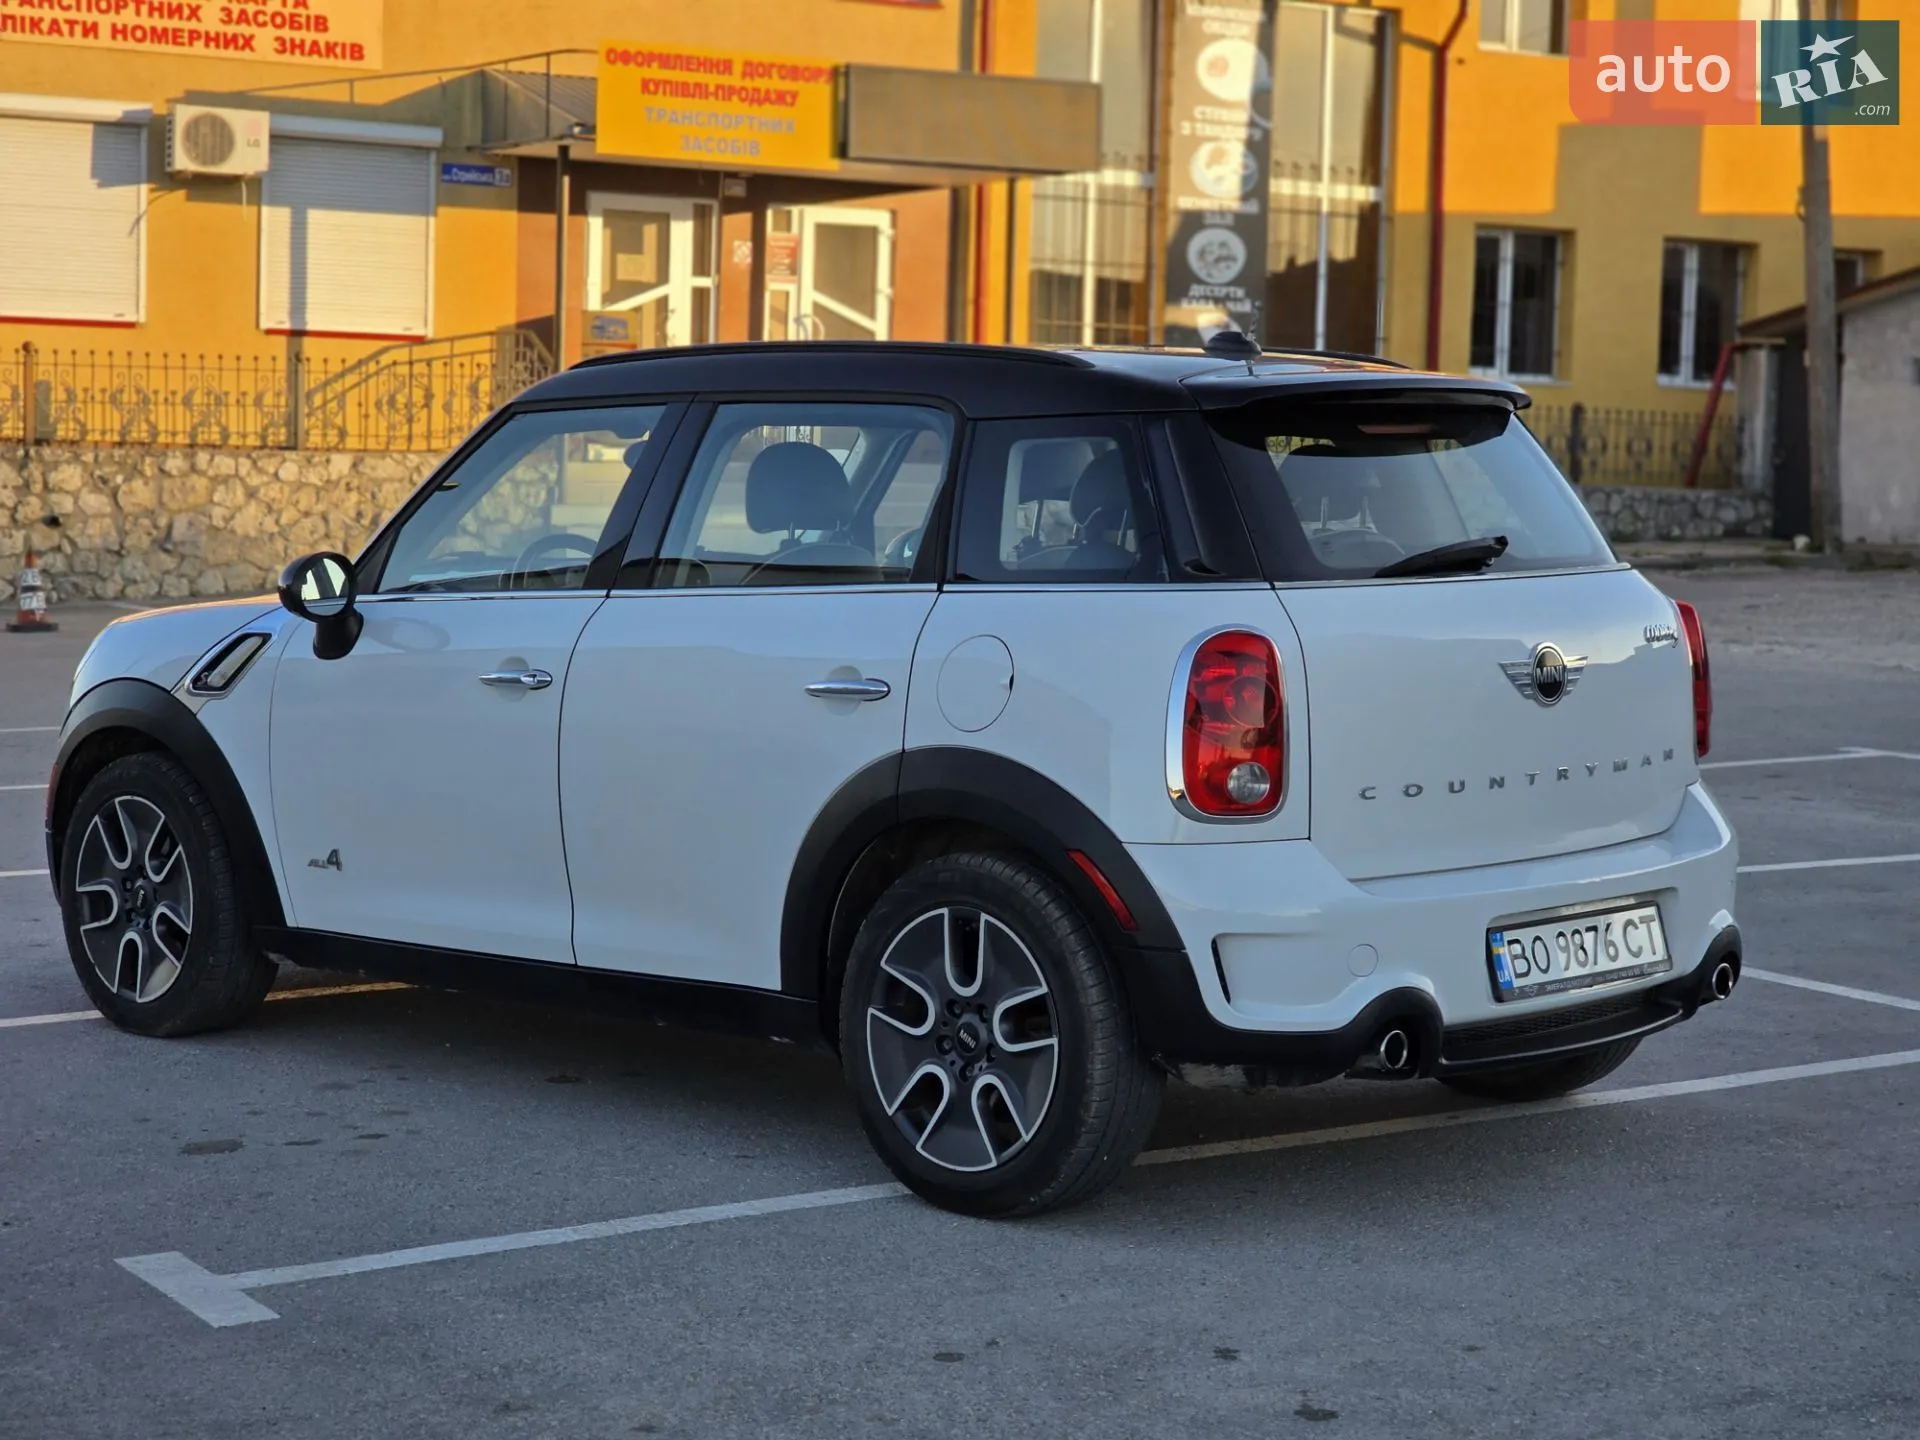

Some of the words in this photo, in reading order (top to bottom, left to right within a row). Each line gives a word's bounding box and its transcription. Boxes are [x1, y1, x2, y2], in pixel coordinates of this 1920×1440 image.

[219, 6, 330, 33] ЗАСОБІВ
[110, 22, 256, 52] НОМЕРНИХ
[273, 36, 365, 61] ЗНАКІВ
[605, 47, 734, 76] ОФОРМЛЕННЯ
[640, 77, 799, 107] КУПІВЛІ-ПРОДАЖУ
[644, 106, 797, 134] ТРАНСПОРТНИХ
[681, 134, 761, 157] ЗАСОБІВ
[1535, 664, 1564, 685] MINI
[1358, 748, 1674, 801] COUNTRYMAN
[1507, 934, 1551, 979] BO
[1555, 921, 1620, 972] 9876
[1622, 914, 1657, 960] CT
[1498, 970, 1512, 983] UA
[959, 1028, 977, 1049] MINI
